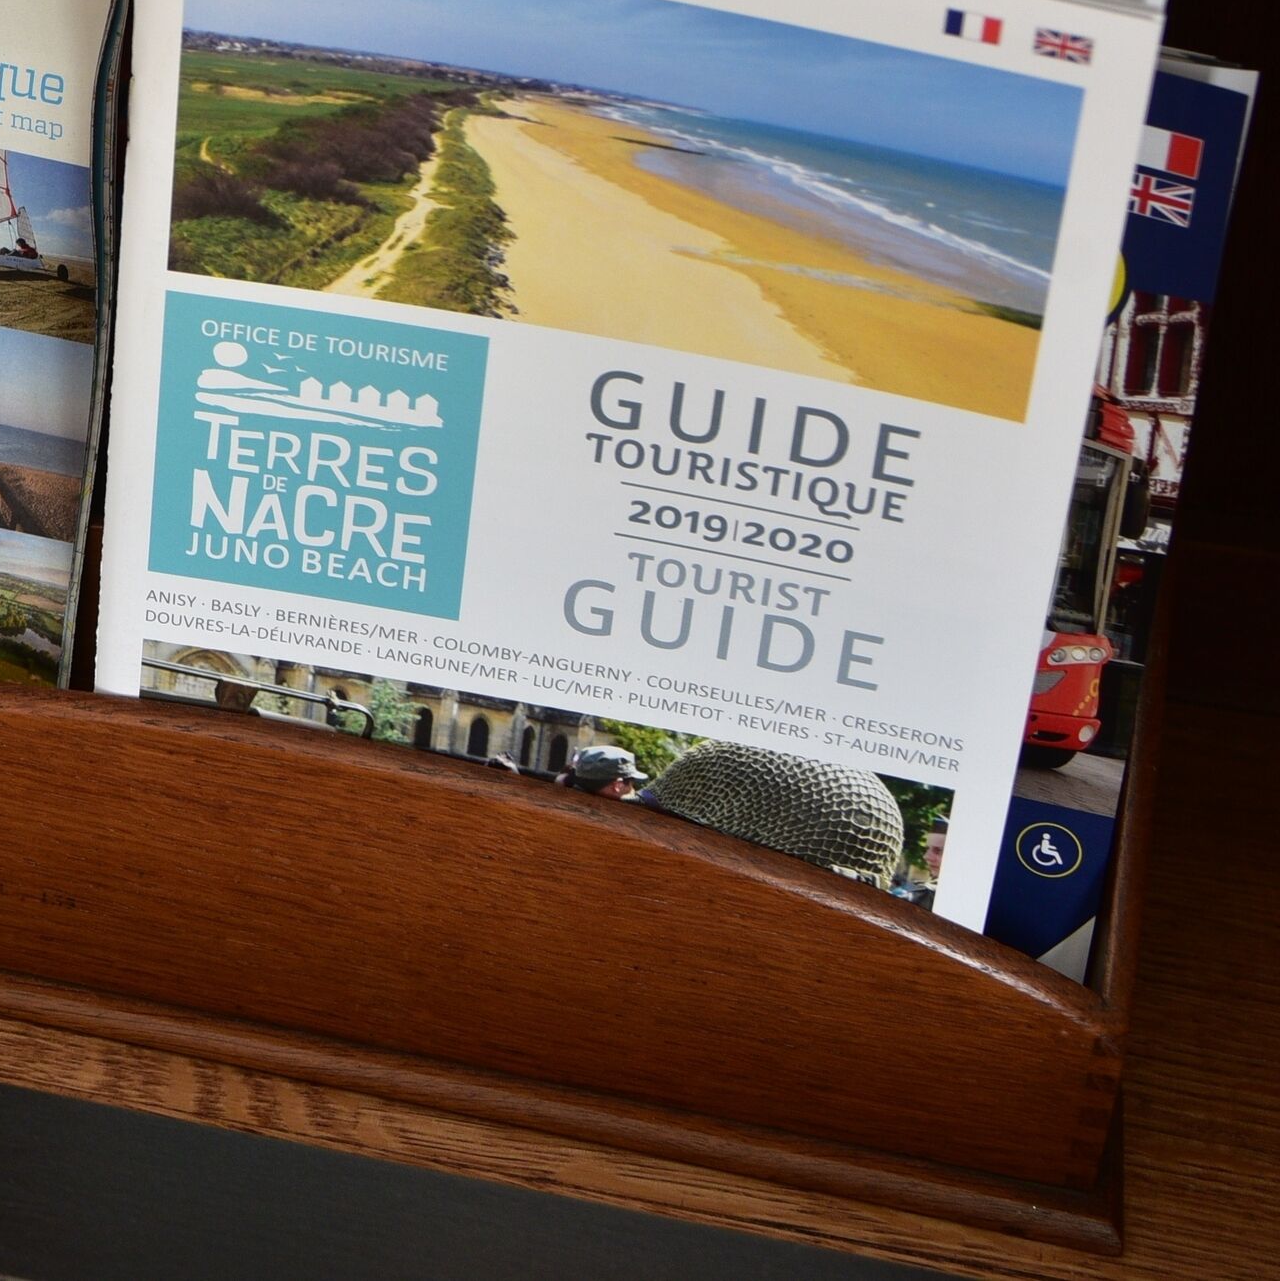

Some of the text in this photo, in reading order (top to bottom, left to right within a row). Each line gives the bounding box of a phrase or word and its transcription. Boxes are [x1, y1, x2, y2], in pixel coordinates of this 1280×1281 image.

[11, 112, 64, 140] map
[201, 319, 449, 371] OFFICE DE TOURISME
[194, 411, 438, 496] TERRES
[590, 370, 921, 487] GUIDE
[190, 468, 432, 564] NACRE
[263, 474, 288, 493] DE
[586, 432, 906, 523] TOURISTIQUE
[185, 532, 426, 592] JUNO BEACH
[627, 552, 831, 617] TOURIST
[146, 589, 964, 752] ANISY BASLY BERNIÈRES/MER COLOMBY-ANGUERNY COURSEULLES/MER CRESSERONS
[563, 579, 884, 691] GUIDE
[145, 609, 960, 773] DOUVRES-LA-DÉLIVRANDE LANGRUNE/MER LUC/MER PLUMETOT REVIERS ST-AUBIN/MER
